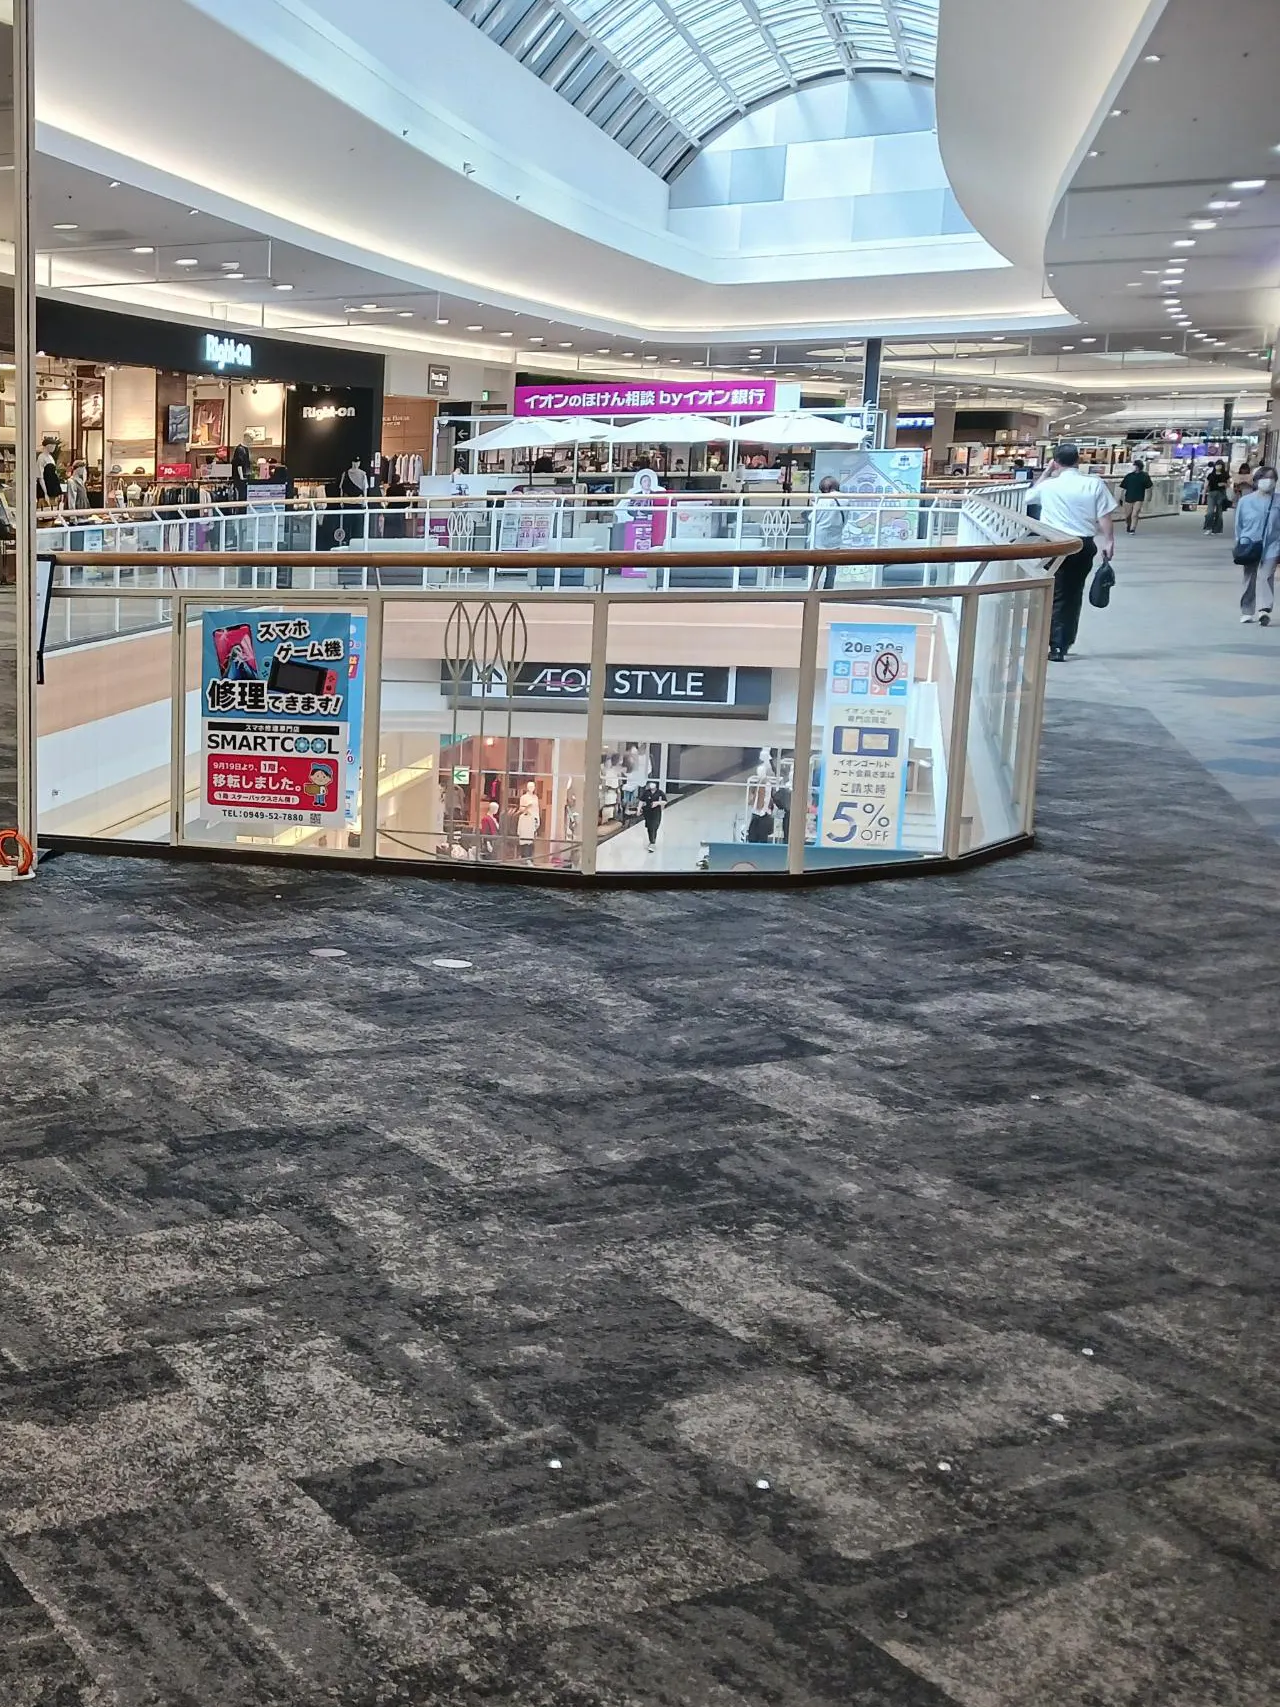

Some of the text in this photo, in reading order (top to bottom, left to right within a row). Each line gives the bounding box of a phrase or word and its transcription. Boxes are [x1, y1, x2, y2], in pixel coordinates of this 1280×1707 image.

[525, 390, 655, 409] イオンのほけん相談
[258, 621, 309, 640] スマホ
[277, 641, 342, 661] ゲーム機
[614, 669, 705, 697] STYLE
[845, 708, 892, 716] イオンモール
[244, 724, 300, 733] スマホ修理専門店
[207, 733, 339, 755] SMARTCOOL
[212, 774, 302, 793] 移転しました。
[840, 783, 886, 796] ご請求時
[861, 829, 889, 841] OFF
